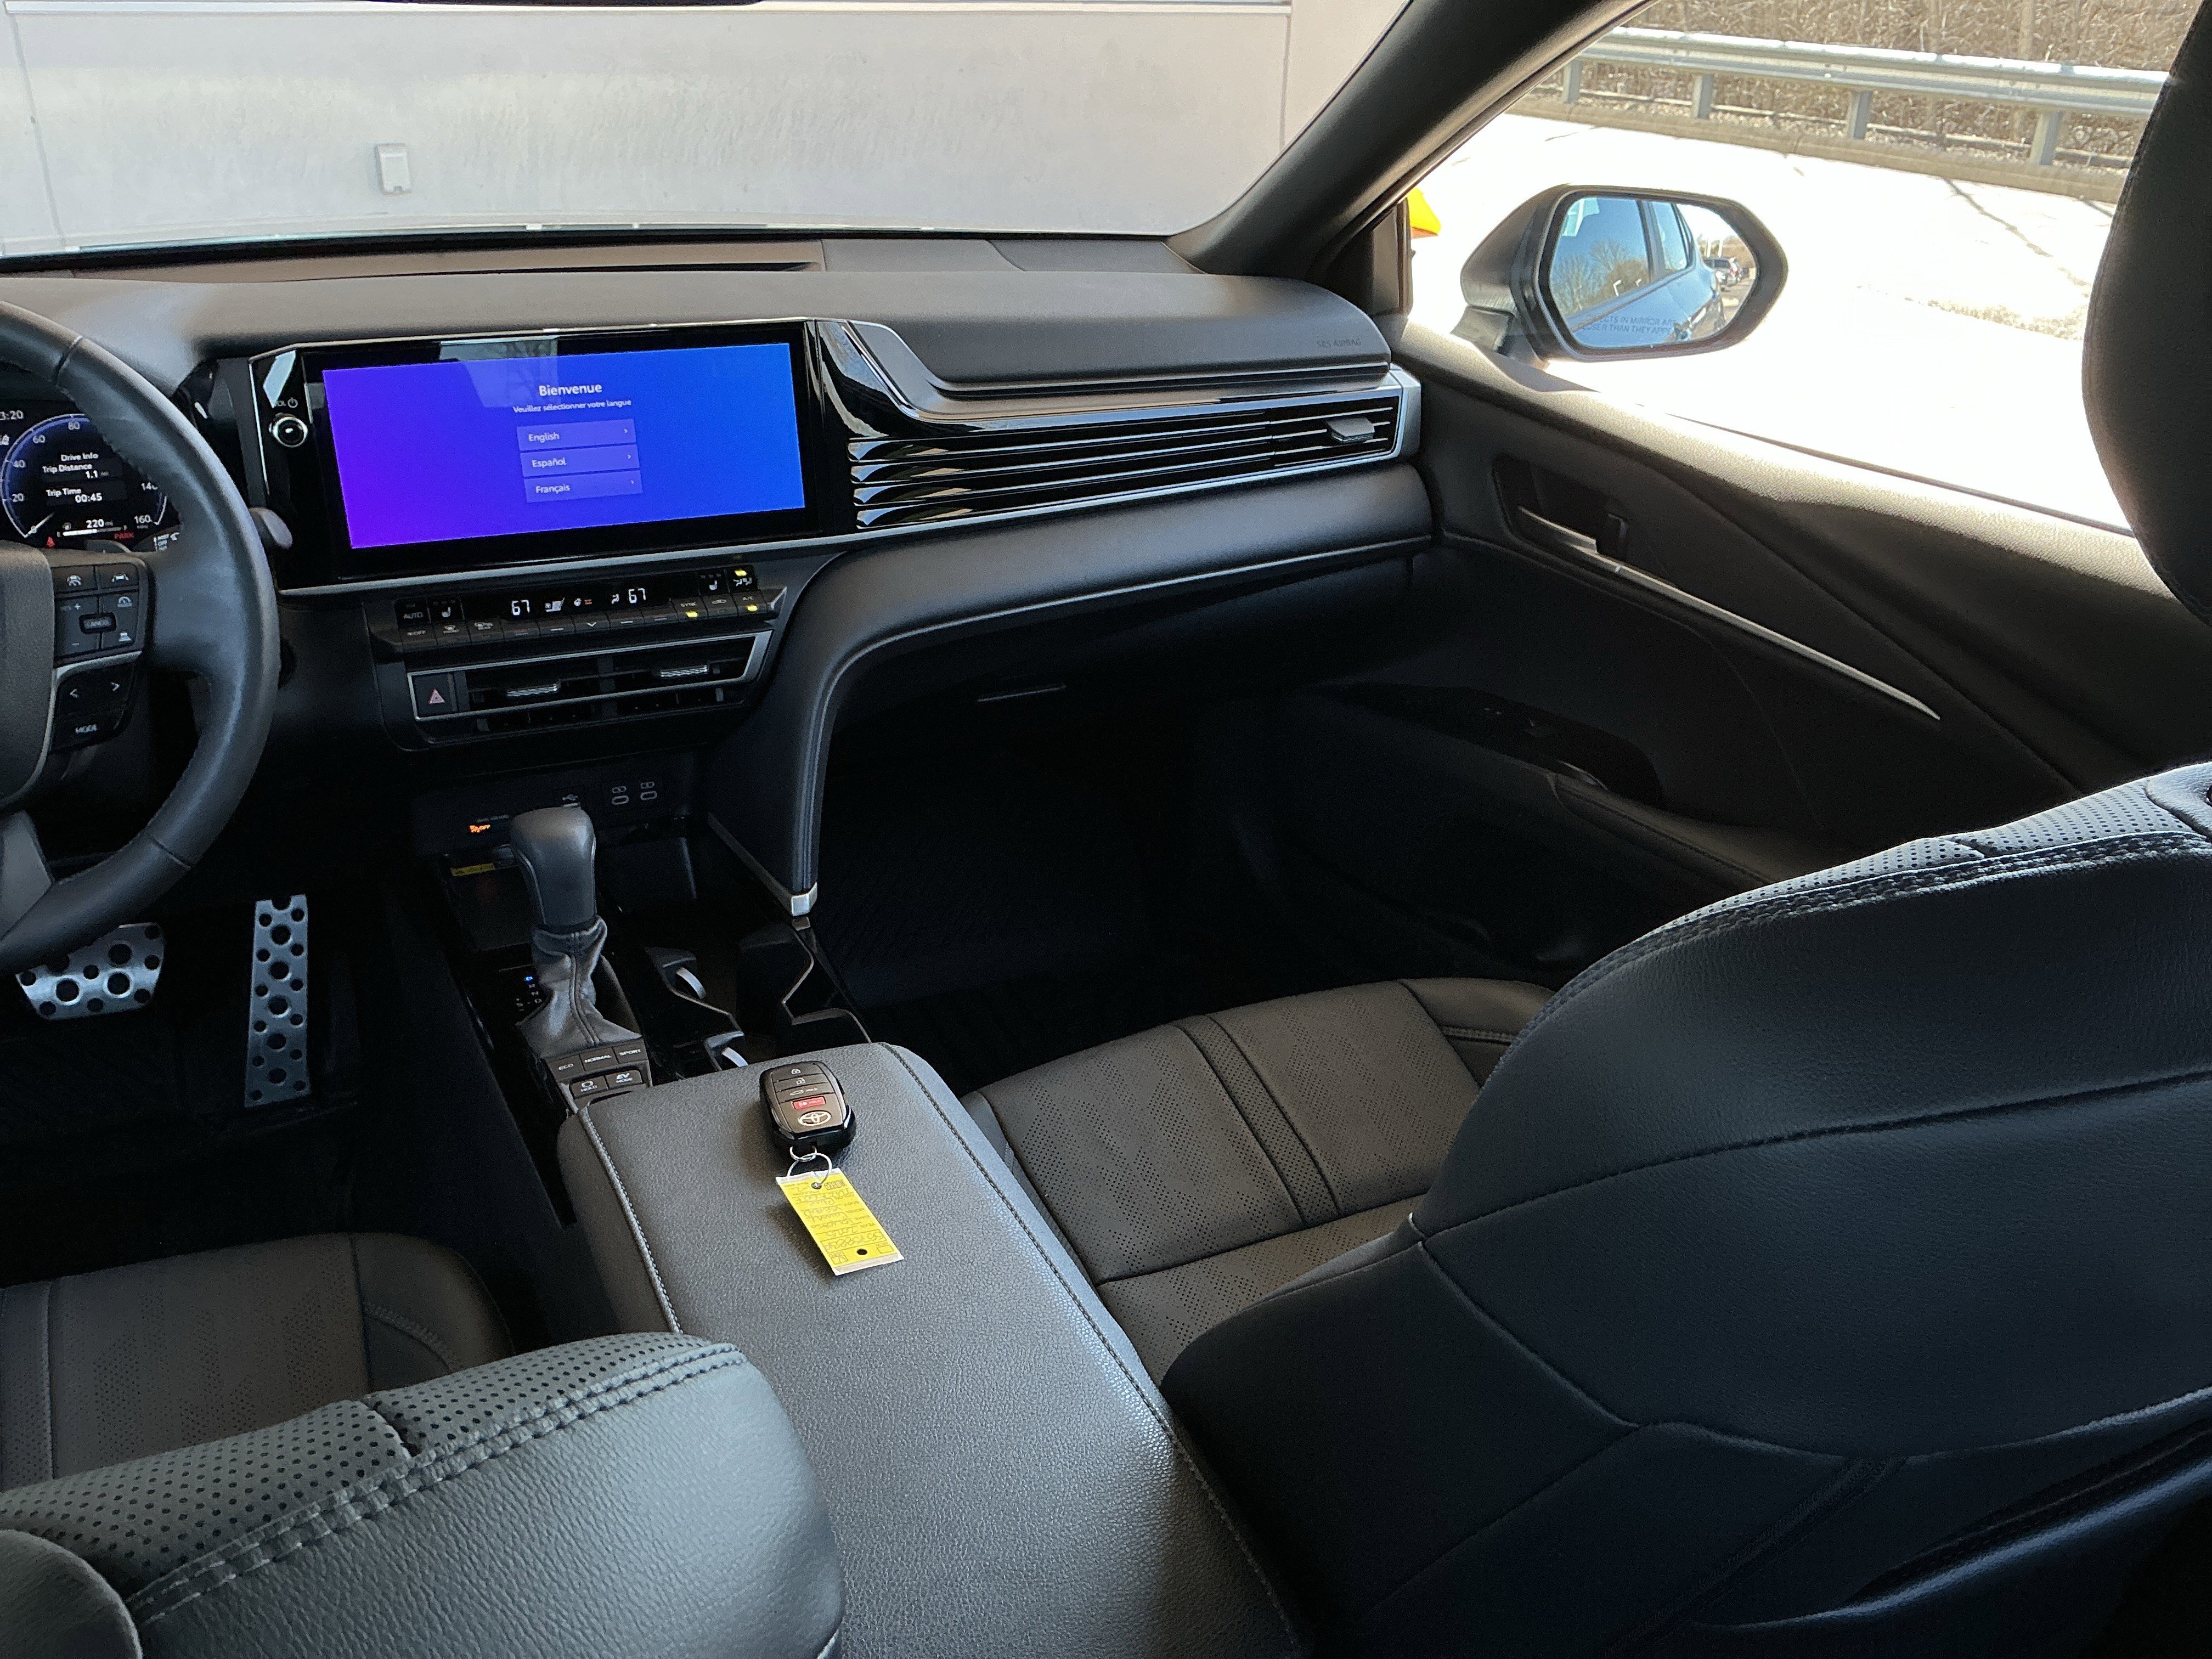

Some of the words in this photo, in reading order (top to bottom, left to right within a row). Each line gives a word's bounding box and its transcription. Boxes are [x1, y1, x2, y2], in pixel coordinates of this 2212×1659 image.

[1610, 324, 1630, 332] THAN
[1317, 340, 1331, 348] SRS
[1334, 338, 1362, 347] AIRBAG
[539, 384, 603, 397] Bienvenue
[543, 402, 586, 411] sélectionner
[588, 400, 606, 409] votre
[606, 399, 632, 409] langue
[68, 421, 80, 430] 80
[33, 435, 46, 444] 60
[528, 432, 560, 443] English
[13, 460, 26, 468] 40
[532, 457, 567, 469] Español
[42, 465, 58, 474] Trip
[58, 464, 93, 472] Distance
[85, 470, 98, 479] 1.1
[46, 489, 62, 498] Trip
[535, 483, 571, 494] Français
[12, 493, 24, 503] 20
[75, 492, 103, 503] 00:45
[86, 518, 104, 528] 220
[134, 515, 151, 524] 160
[628, 588, 647, 604] 67
[511, 600, 531, 616] 67
[584, 1054, 612, 1063] NORMAL
